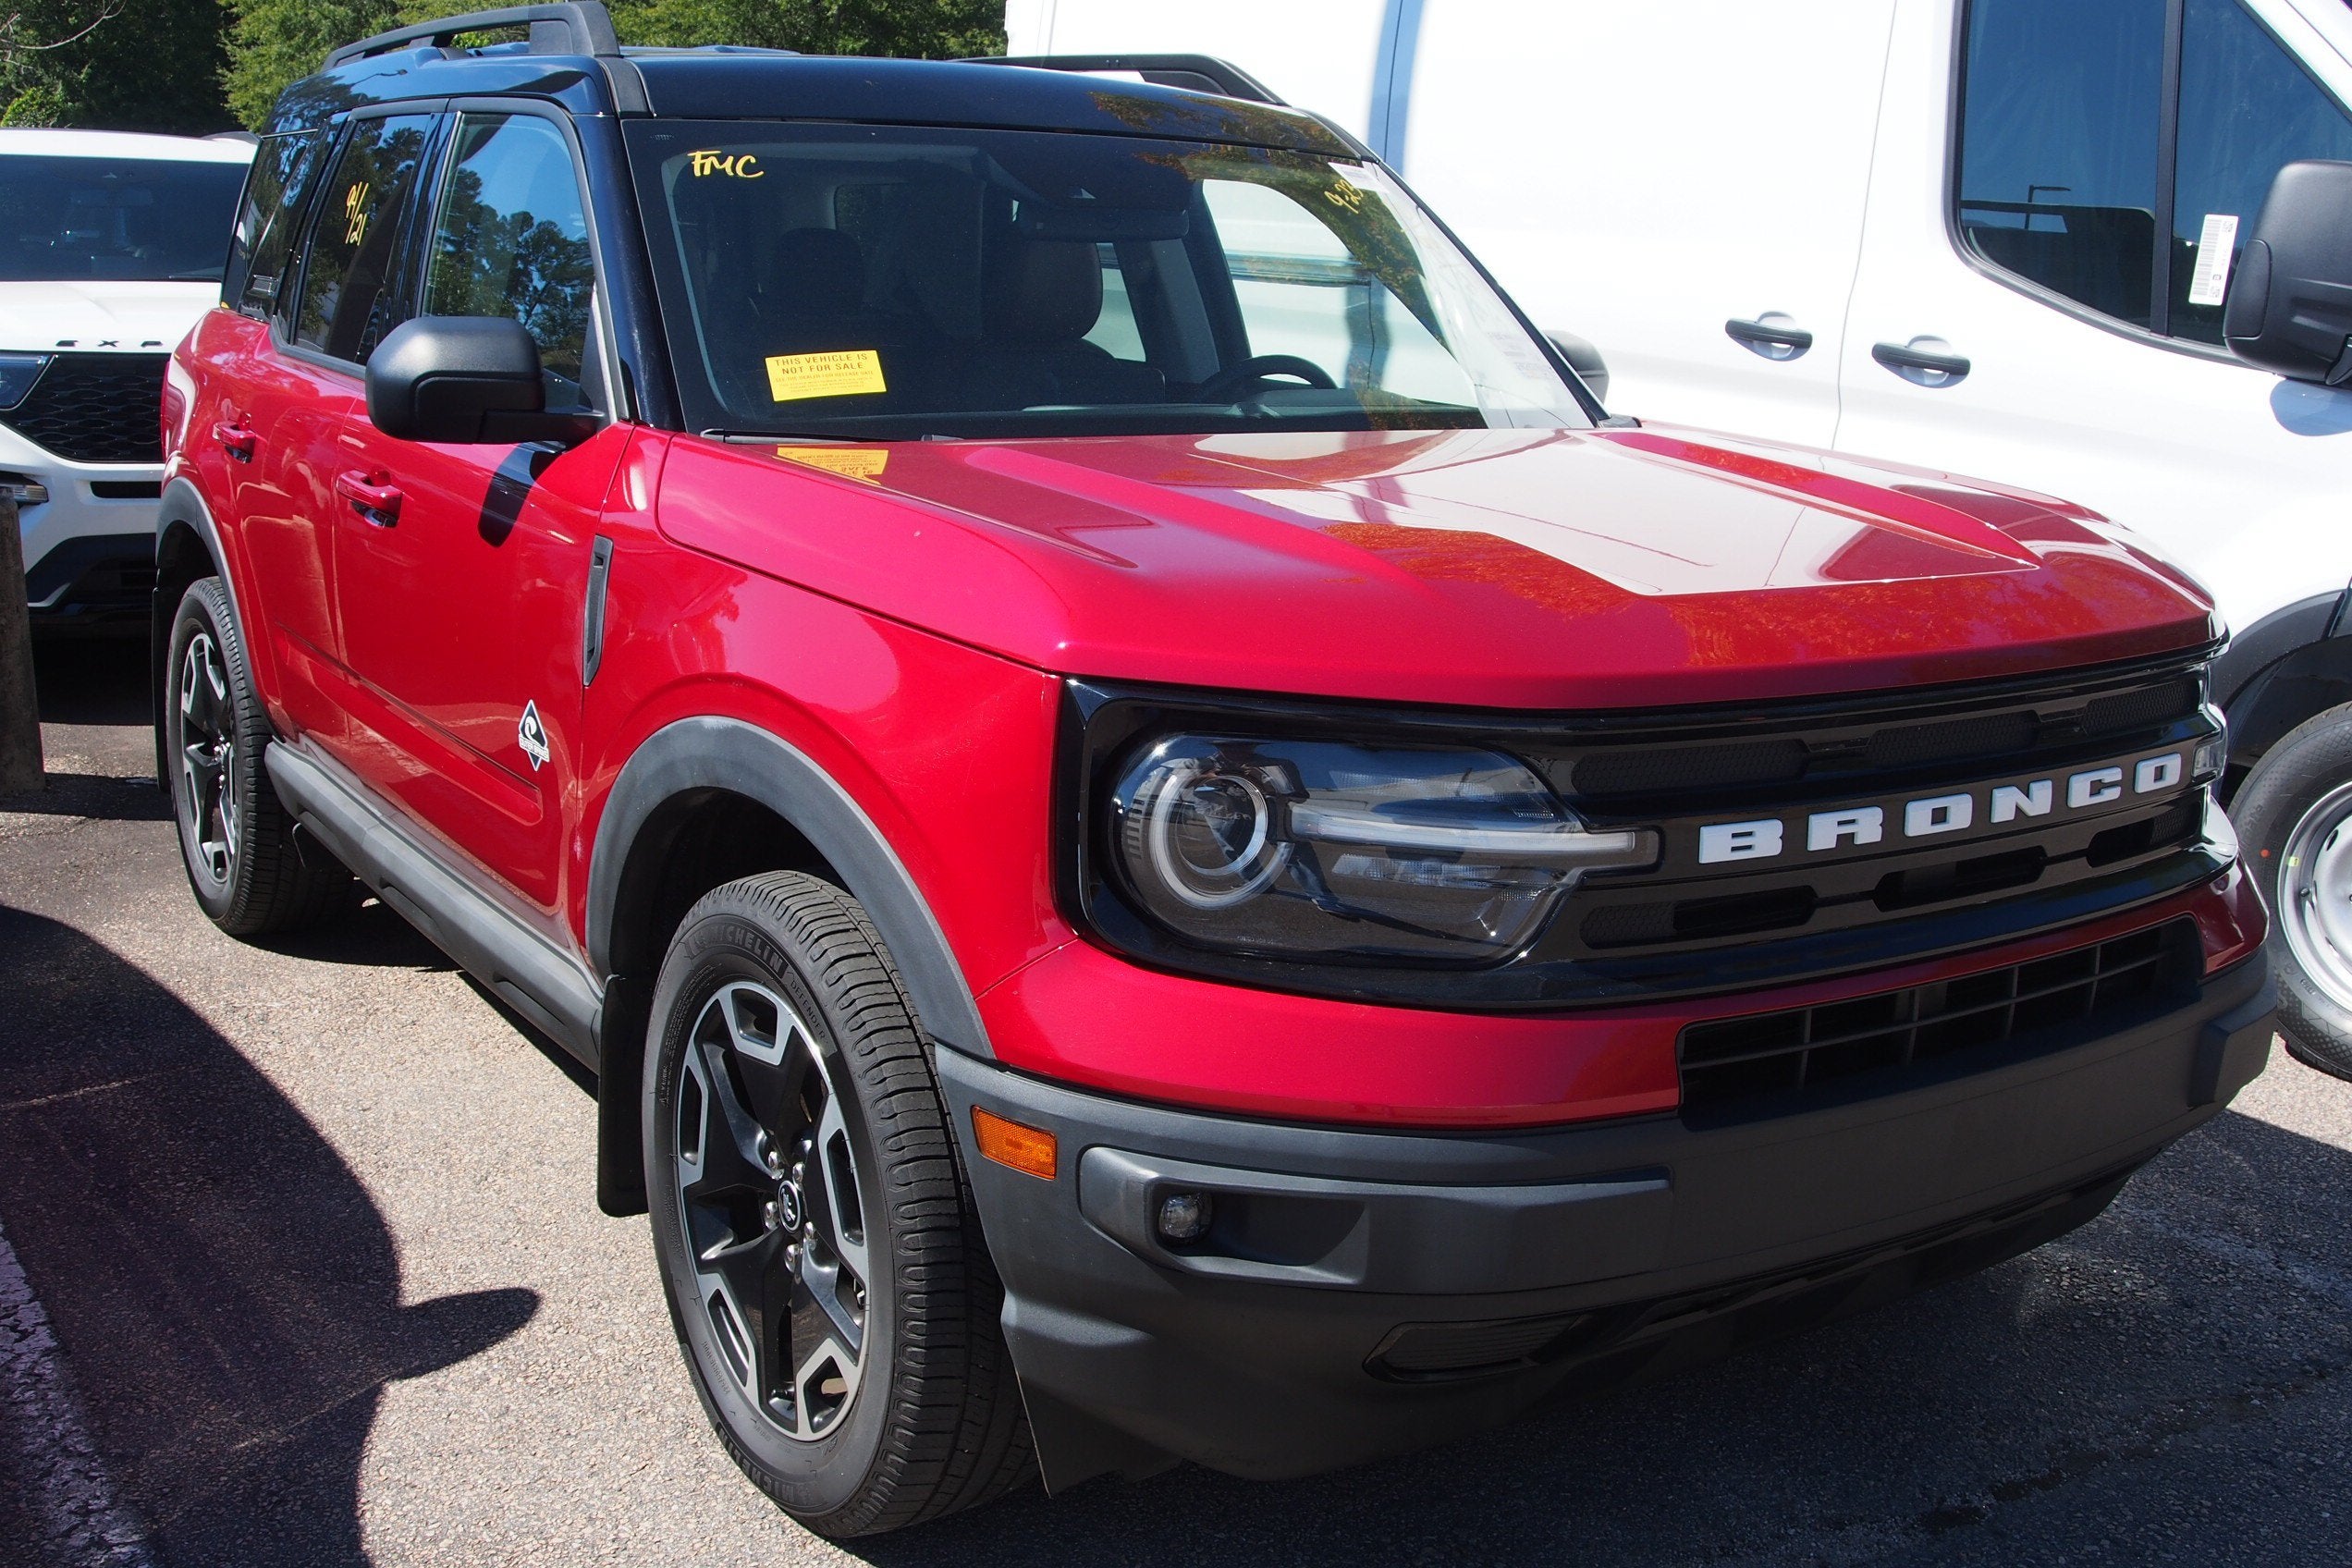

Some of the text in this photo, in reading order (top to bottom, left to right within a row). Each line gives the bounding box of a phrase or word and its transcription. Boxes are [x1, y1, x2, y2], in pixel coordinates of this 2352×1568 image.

[687, 150, 765, 178] FMC
[775, 352, 868, 366] THIS VEHICLE IS
[781, 361, 864, 374] NOT FOR SALE
[1697, 752, 2182, 864] BRONCO
[790, 980, 826, 1040] DEFENDER
